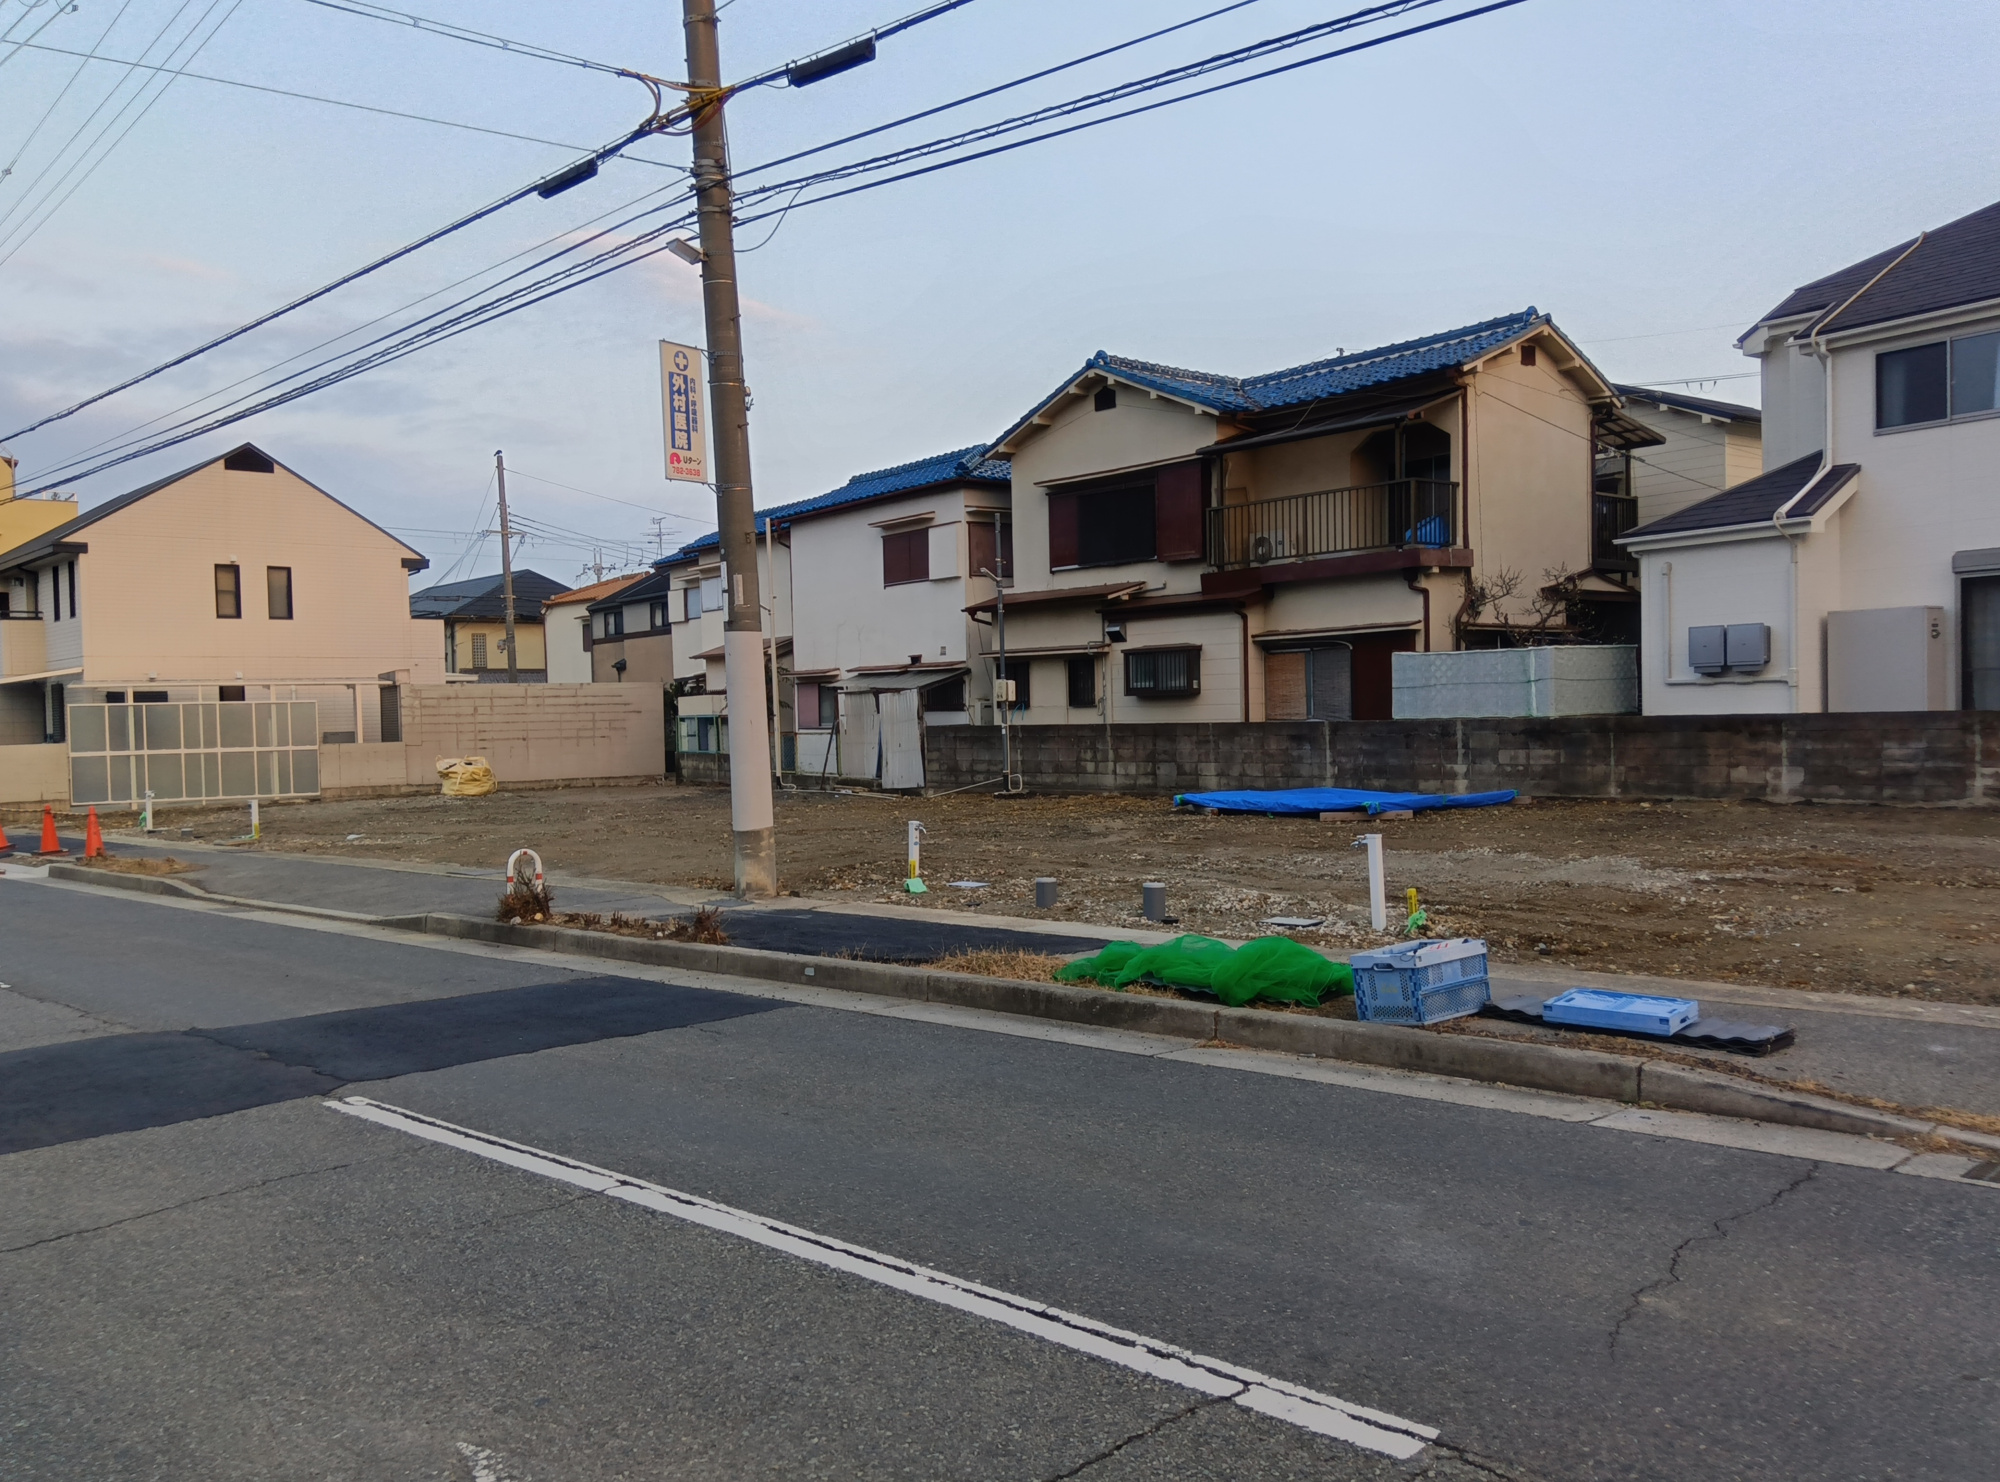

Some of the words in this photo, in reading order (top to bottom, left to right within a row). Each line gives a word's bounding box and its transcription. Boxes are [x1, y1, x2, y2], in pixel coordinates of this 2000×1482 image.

[672, 374, 689, 449] 外村医院
[683, 456, 702, 465] Uターン
